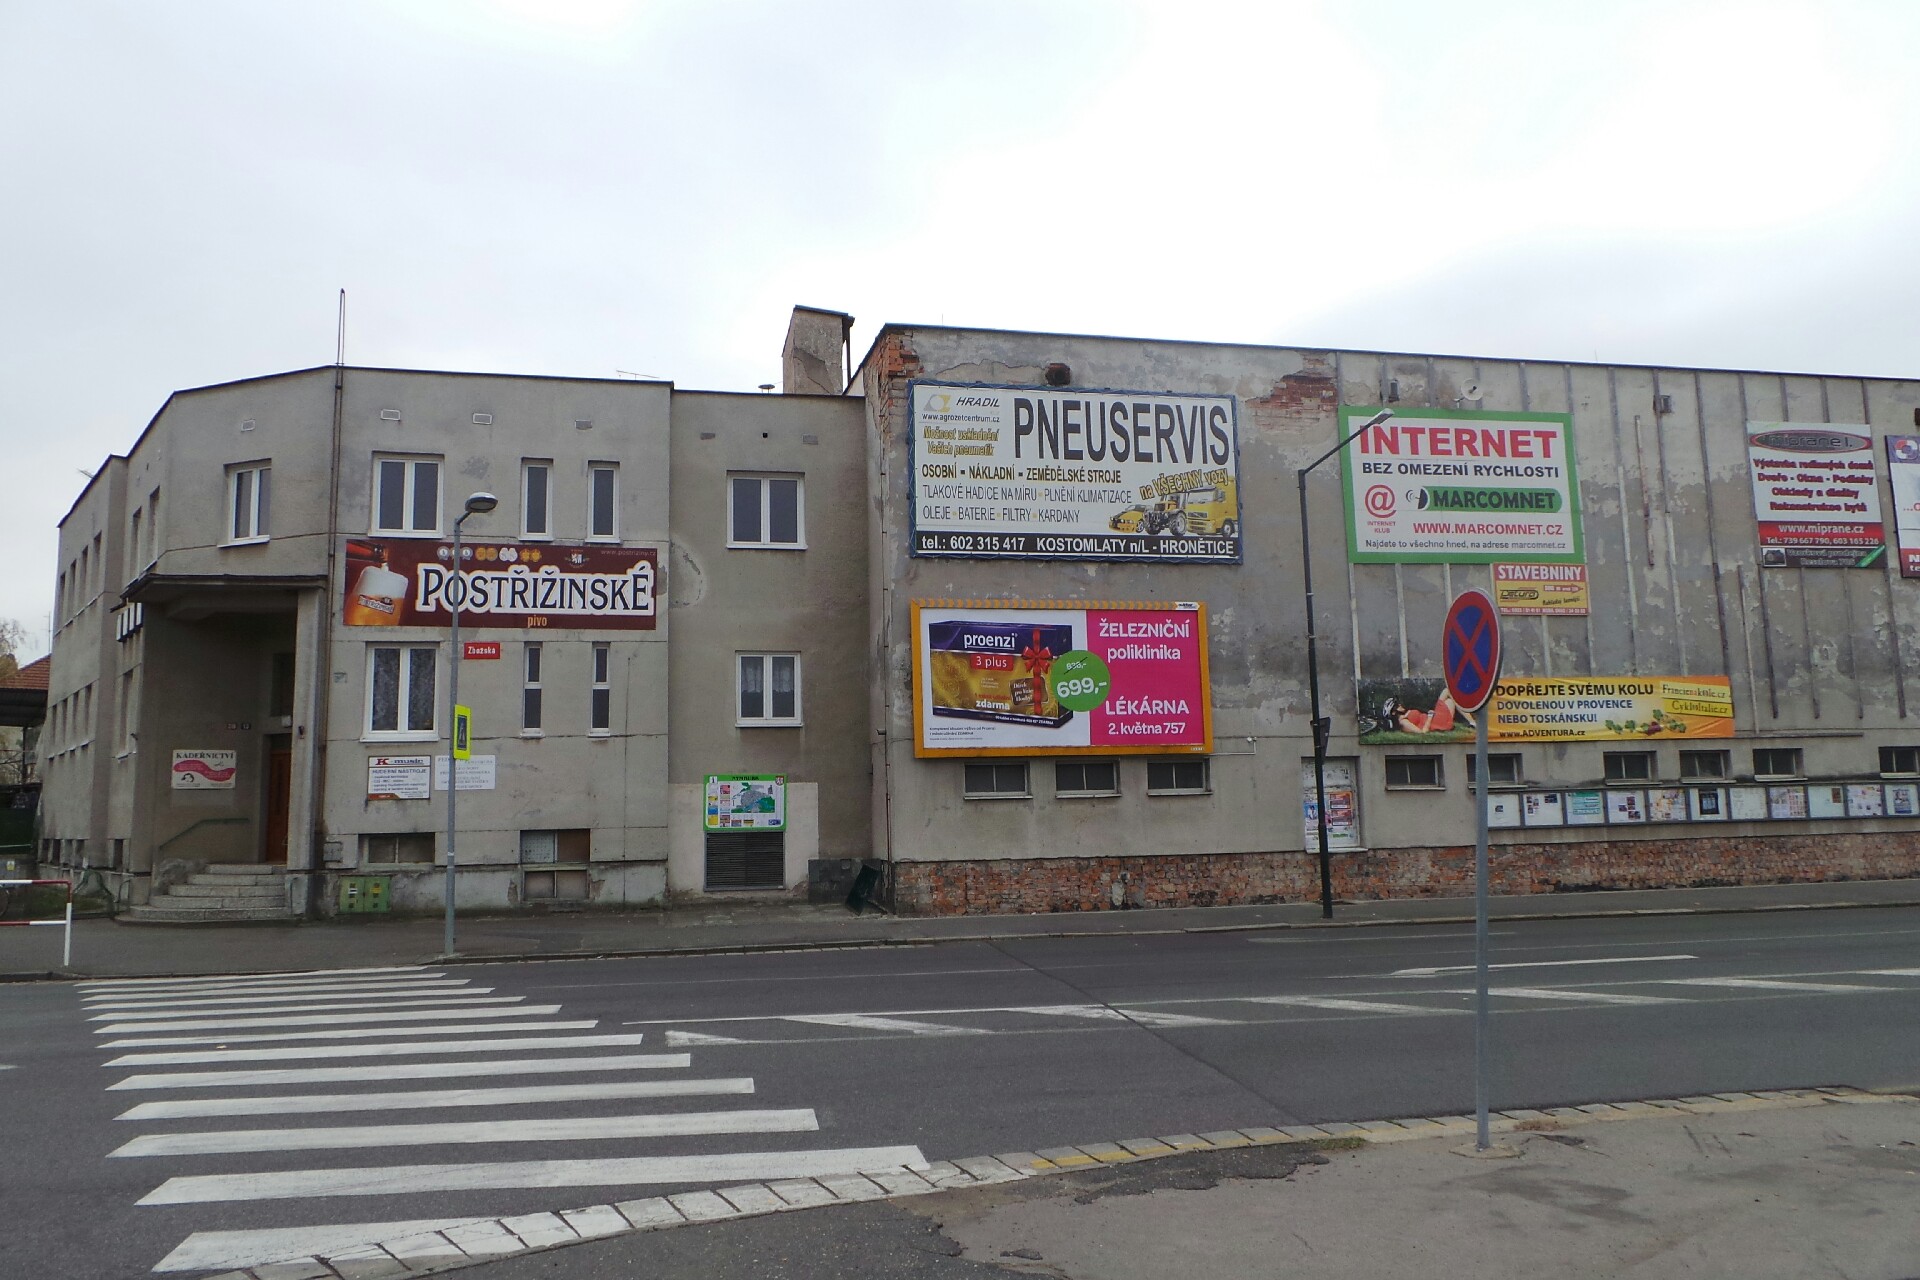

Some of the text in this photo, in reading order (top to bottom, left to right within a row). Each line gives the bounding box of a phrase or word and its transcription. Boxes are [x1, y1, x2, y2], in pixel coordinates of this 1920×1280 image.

[956, 396, 1000, 408] HRADIL
[921, 413, 1000, 423] www.agrozetcentrum.cz
[923, 426, 999, 442] Možnost uskladnění
[1014, 397, 1230, 466] PNEUSERVIS
[927, 442, 995, 458] Vašich pneumatik
[1360, 425, 1557, 459] INTERNET
[921, 463, 957, 479] OSOBNÍ
[969, 464, 1015, 481] NÁKLADNÍ
[1026, 466, 1086, 483] ZEMĚDĚLSKÉ
[1087, 470, 1122, 484] STROJE
[1362, 462, 1559, 478] BEZ OMEZENÍ RYCHLOSTI
[1139, 469, 1229, 500] na VŠECHNY vozy
[923, 484, 1132, 504] TLAKOVÉ HADICE NA MÍRU PLNĚNÍ KLIMATIZACE
[1433, 490, 1555, 510] MARCOMNET
[923, 505, 1080, 523] OLEJE BATERIE FILTRY KARDANY
[1413, 522, 1564, 536] WWW.MARCOMNET.CZ
[1778, 524, 1865, 535] www.miprane.cz
[922, 535, 946, 550] tel.:
[950, 535, 975, 550] 602
[977, 536, 1001, 551] 315
[1003, 537, 1026, 551] 417
[1037, 538, 1129, 553] KOSTOMLATY
[1130, 539, 1150, 554] n/L
[1160, 535, 1234, 555] HRONĚTICE
[1366, 539, 1396, 549] Najdete
[1398, 540, 1407, 548] to
[1409, 540, 1444, 548] všechno
[1446, 540, 1469, 549] hned,
[1482, 541, 1509, 549] adrese
[1511, 541, 1566, 549] marcomnet.cz
[1498, 565, 1582, 581] STAVEBNINY
[421, 565, 649, 611] POSTŘIŽINSKÉ
[527, 614, 547, 628] pivo
[1099, 618, 1190, 638] ŽELEZNIČNÍ
[963, 632, 1016, 648] proenzi
[1107, 644, 1181, 663] poliklinika
[976, 657, 1007, 669] 3 plus
[1056, 677, 1107, 698] 699,-
[1496, 682, 1654, 697] DOPŘEJTE SVÉMU KOLU
[975, 699, 1010, 711] zdarma
[1105, 696, 1190, 716] LÉKÁRNA
[1497, 699, 1633, 711] DOVOLENOU V PROVENCE
[1497, 711, 1597, 724] NEBO TOSKÁNSKU!
[1108, 722, 1186, 736] 2. května 757
[1499, 728, 1586, 738] www.ADVENTURA.cz
[176, 751, 234, 759] KADEŘNICTVÍ
